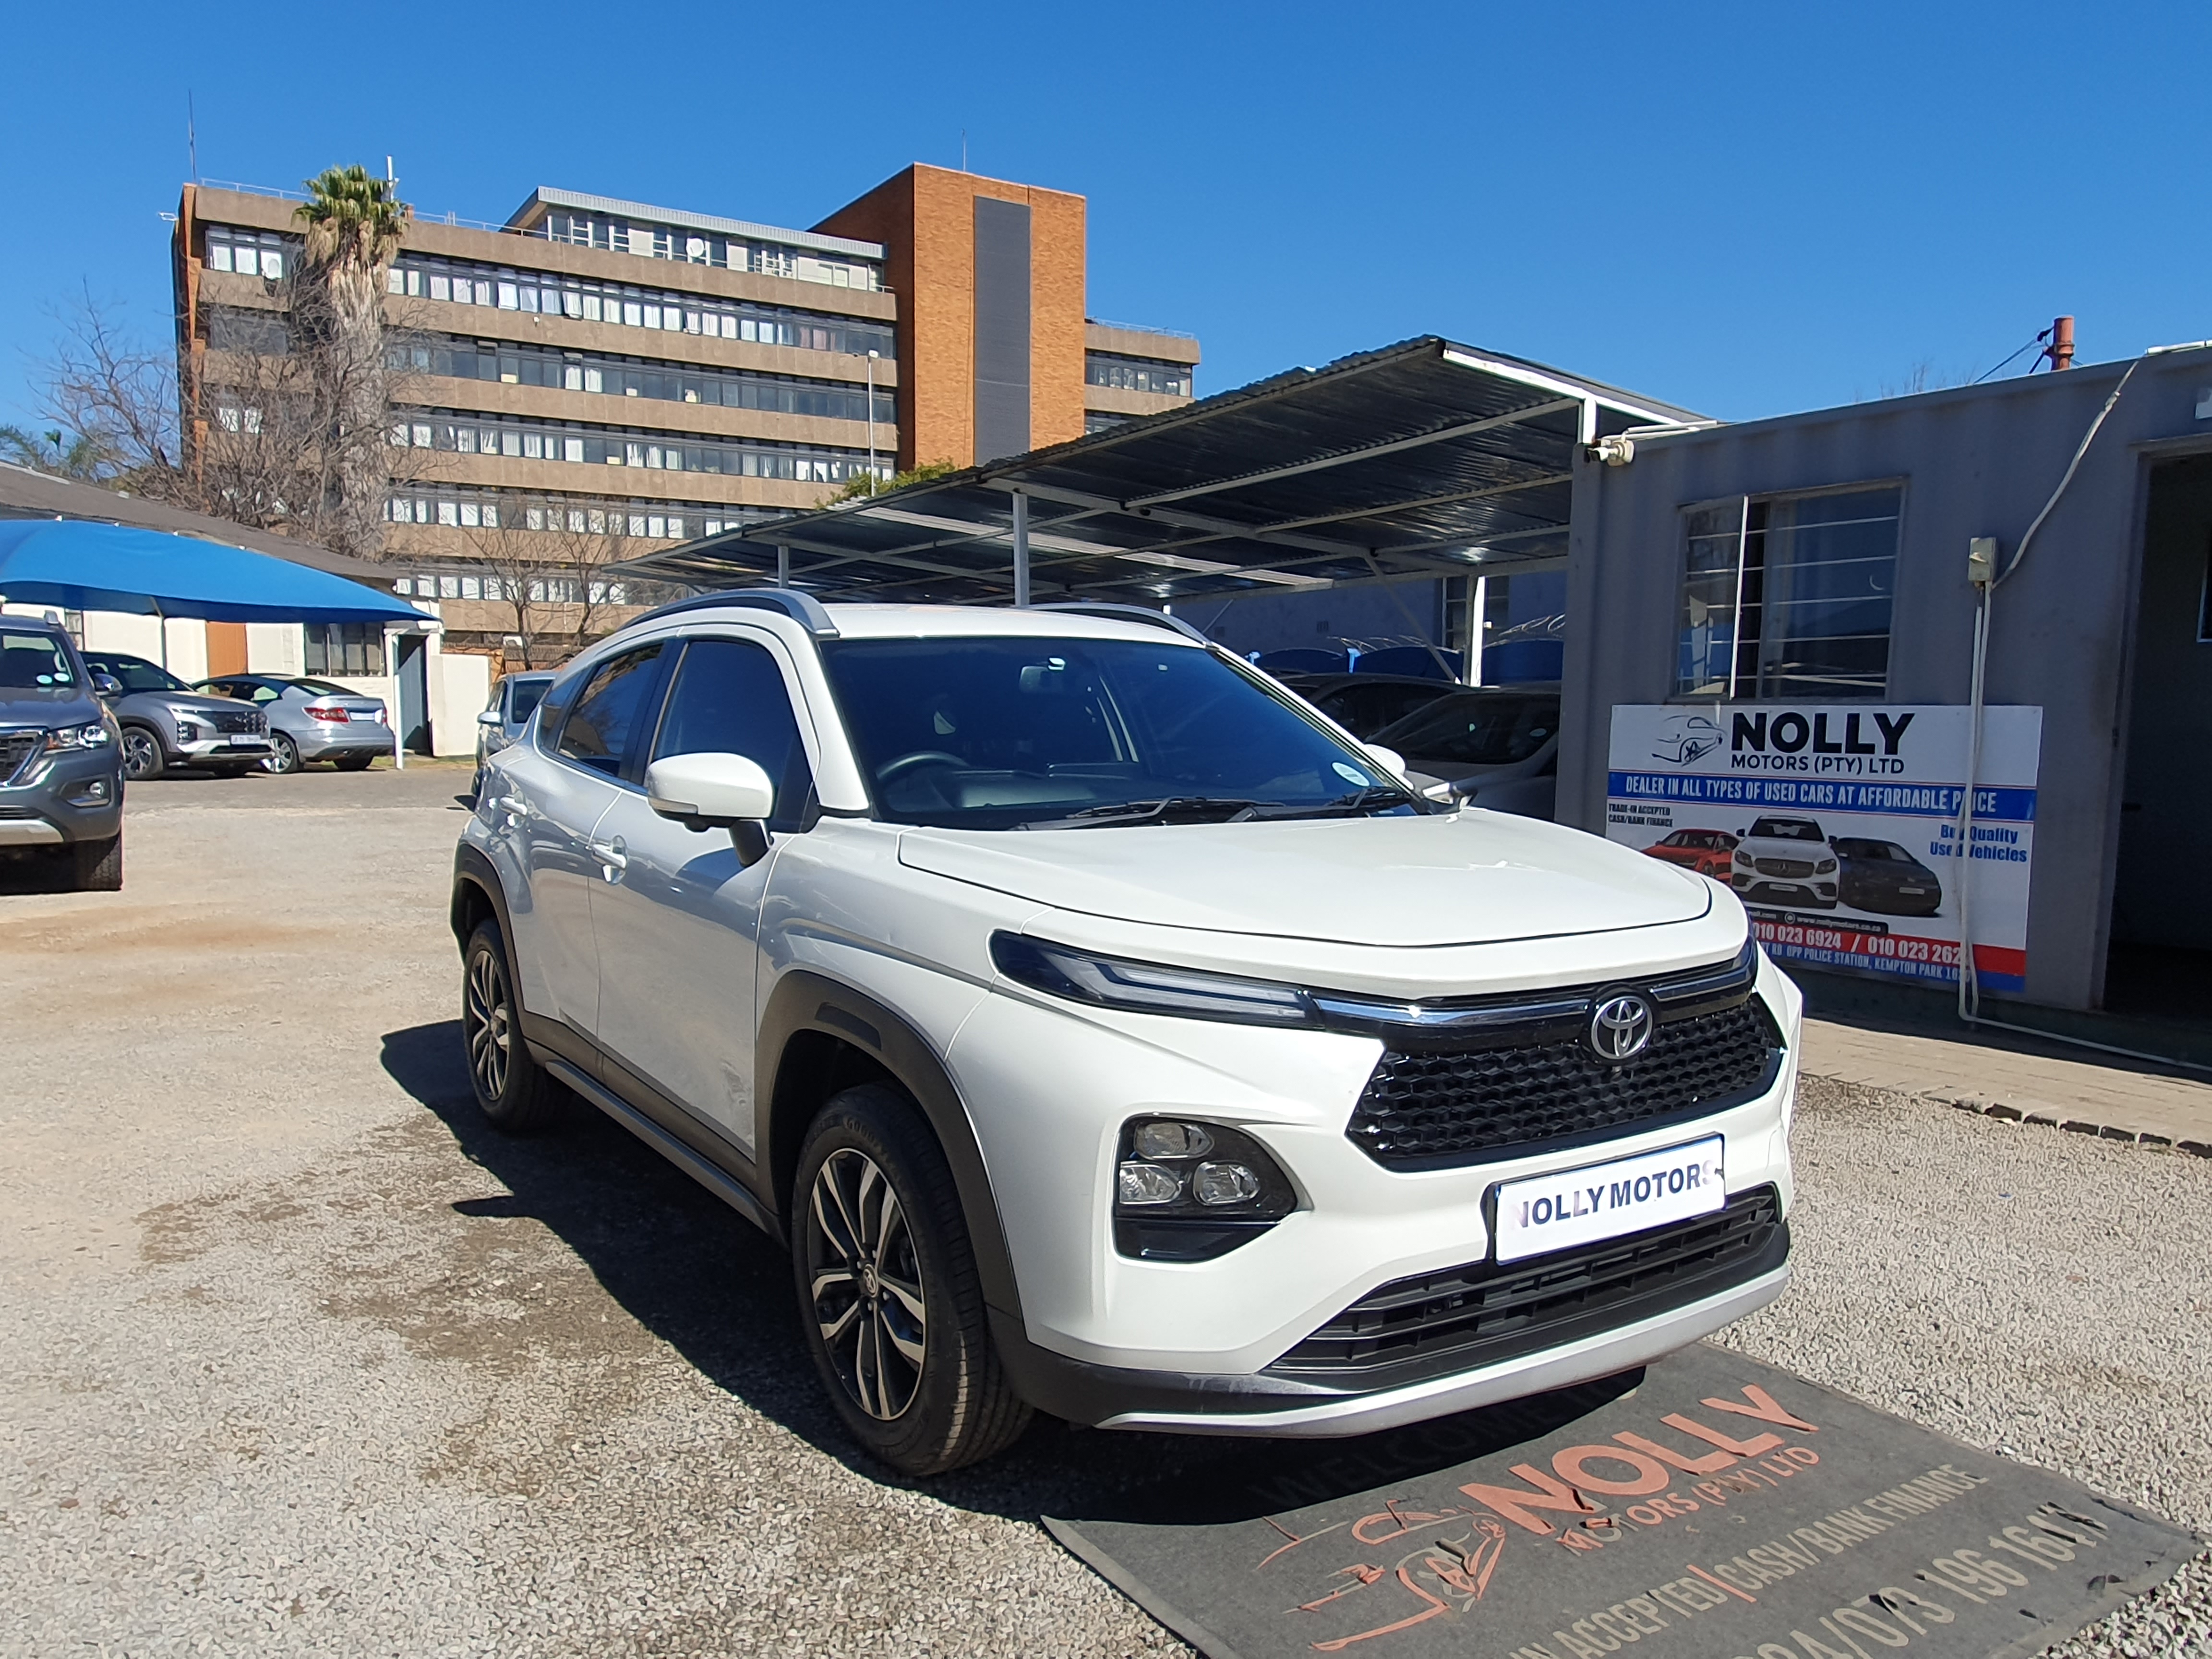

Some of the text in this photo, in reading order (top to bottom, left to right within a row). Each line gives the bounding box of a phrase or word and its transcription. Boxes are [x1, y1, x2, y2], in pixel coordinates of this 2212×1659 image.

[1731, 711, 1916, 755] NOLLY
[1731, 754, 1905, 775] MOTORS (PTY) LTD
[1625, 775, 1997, 812] DEALER IN ALL TYPES OF USED CARS AT AFFORDABLE PICE
[1970, 825, 2018, 844] Quality
[1778, 926, 1803, 944] 023
[1806, 929, 1841, 949] 6924
[1850, 934, 1862, 953] /
[1867, 936, 1895, 956] 010
[1898, 940, 1929, 961] 023
[1932, 944, 1970, 965] 262
[1786, 945, 1803, 958] OPP
[1804, 947, 1832, 961] POLICE
[1834, 951, 1873, 970] STATION,
[1874, 958, 1916, 974] KEMPTON
[1919, 962, 1943, 978] PARK
[1511, 1159, 1715, 1229] NOLLY MOTORS
[1457, 1384, 1819, 1536] NOLLY
[1552, 1576, 1729, 1659] ACCEPTED
[1714, 1505, 1894, 1591] CASH/BANK
[1863, 1463, 1989, 1521] FINANCE
[1914, 1549, 2029, 1604] 196
